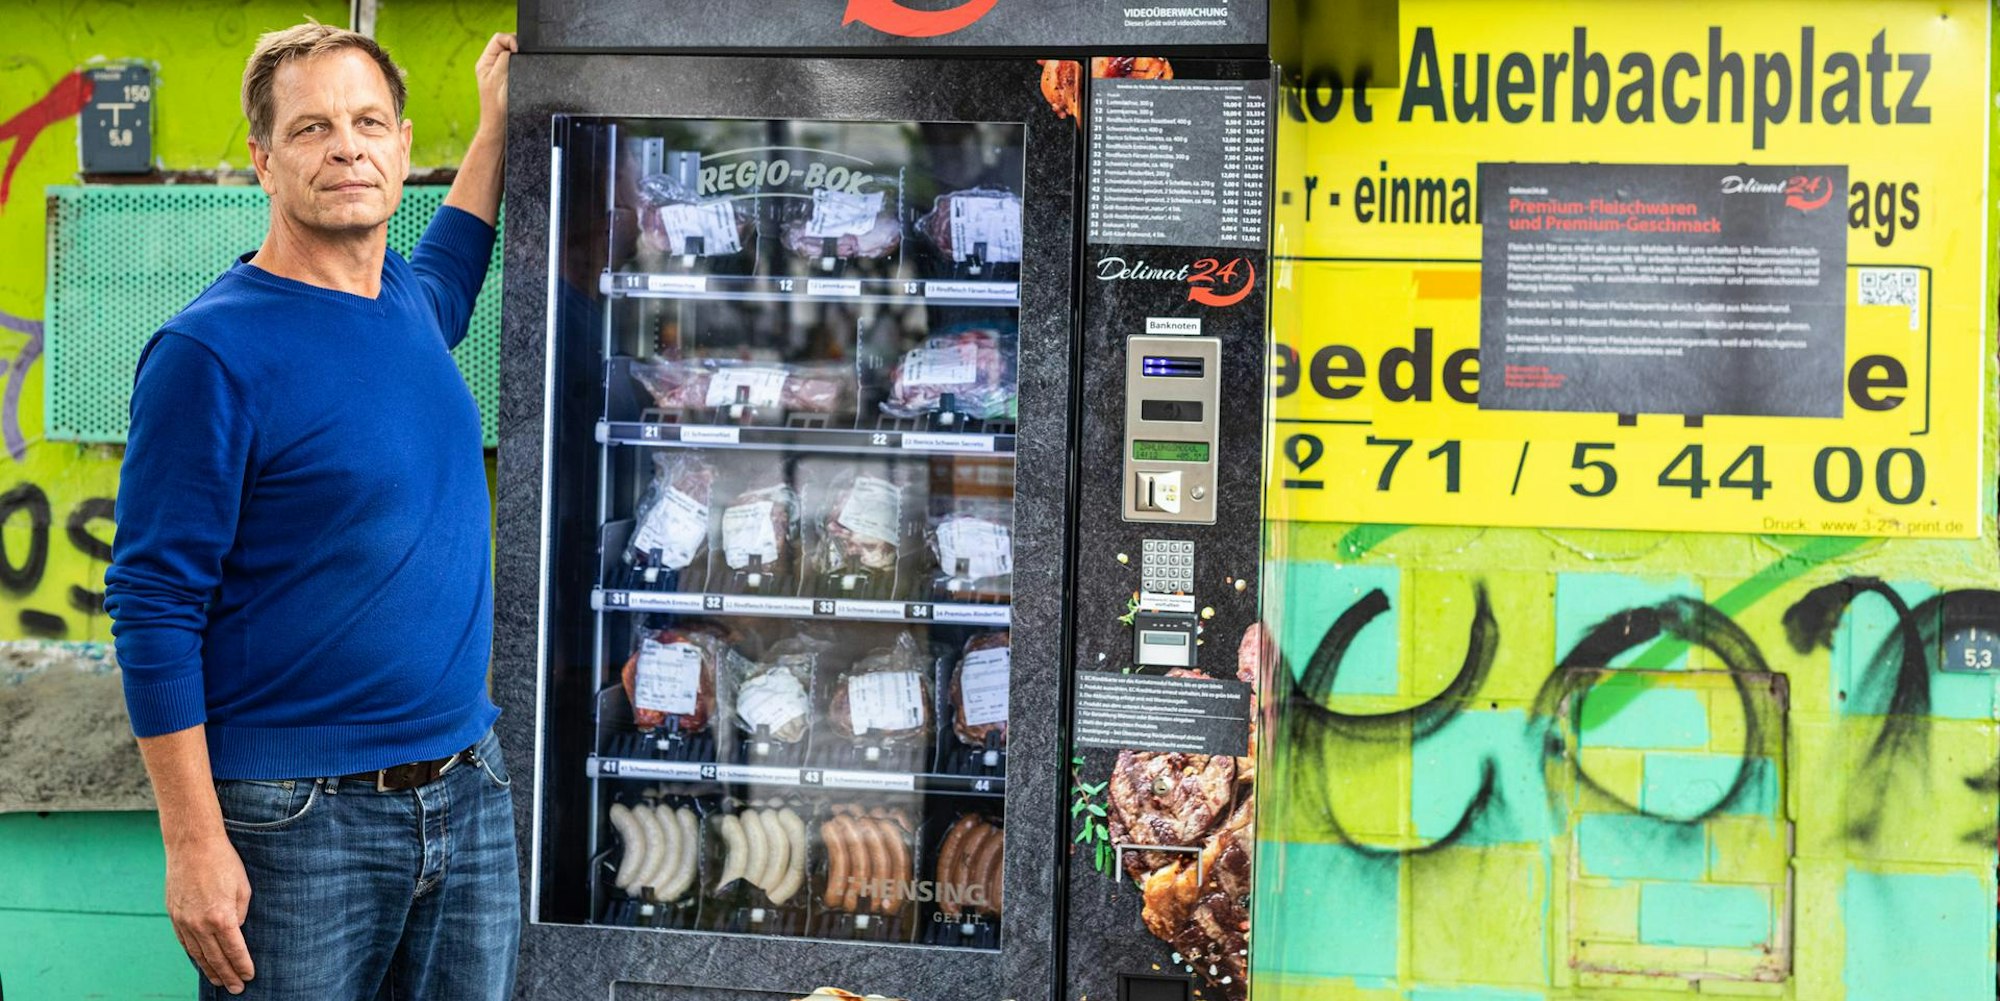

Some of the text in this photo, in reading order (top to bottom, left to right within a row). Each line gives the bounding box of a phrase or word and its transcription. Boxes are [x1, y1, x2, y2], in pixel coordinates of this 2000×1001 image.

[1123, 7, 1228, 18] VIDEOÜBERWACHUNG
[1177, 20, 1227, 28] videoüberwacht.
[123, 84, 151, 102] 150
[1398, 26, 1931, 151] Auerbachplatz
[697, 158, 875, 196] REGIO-BOK
[1509, 198, 1698, 216] Premium-Fleischwaren
[1509, 216, 1722, 233] und Premium-Geschmack
[628, 276, 917, 294] 11 12 13
[1150, 322, 1198, 330] Banknoten
[644, 426, 887, 445] 21 22
[1511, 440, 1530, 497] /
[1569, 441, 1618, 498] 5
[1658, 443, 1773, 501] 44
[1814, 446, 1926, 506] 00
[612, 593, 927, 617] 31 32 33 34
[603, 761, 616, 772] 41
[702, 766, 716, 778] 42
[806, 772, 819, 784] 43
[975, 780, 990, 792] 44
[934, 912, 962, 925] GET
